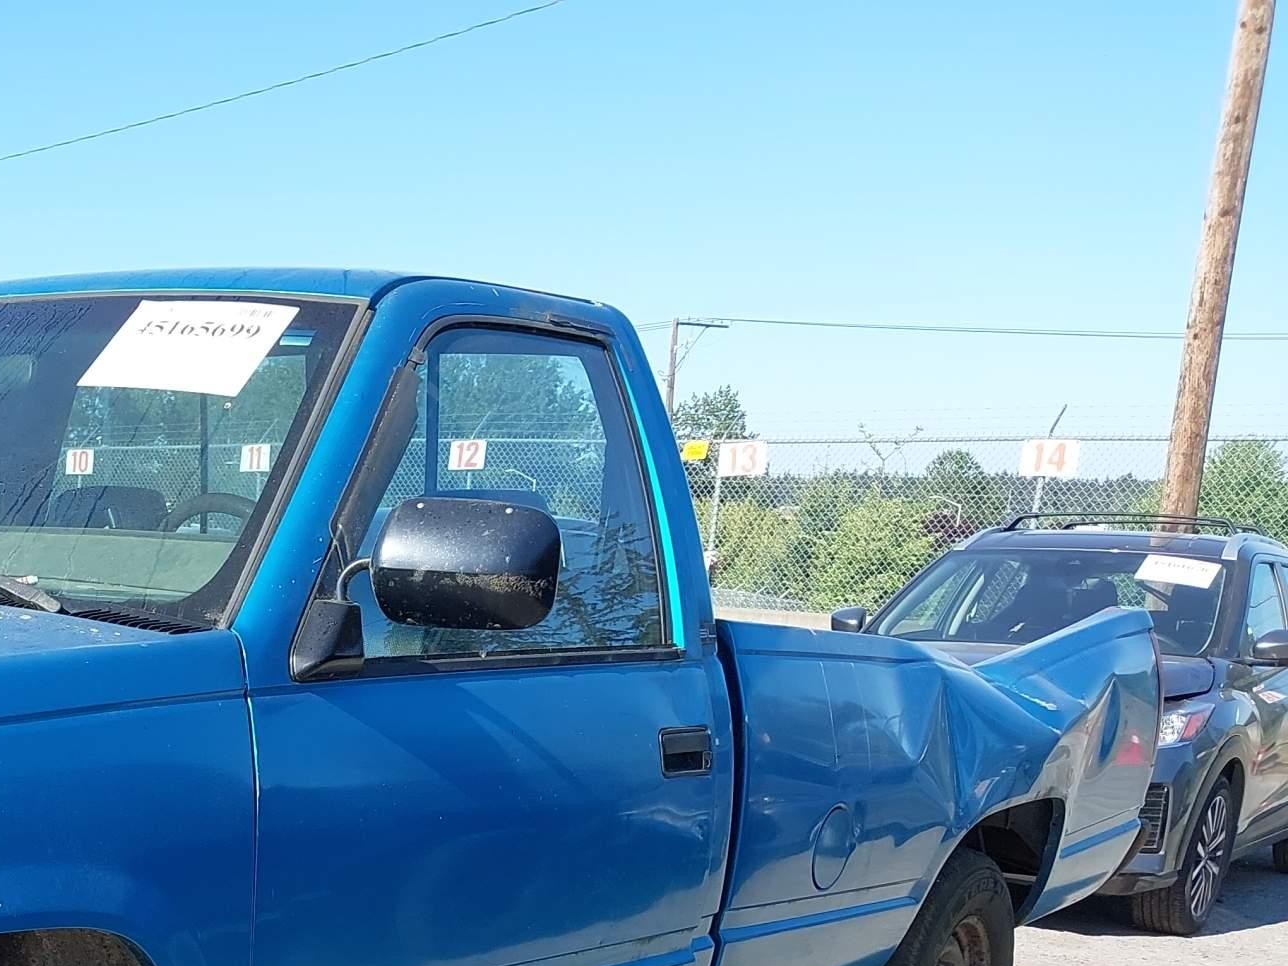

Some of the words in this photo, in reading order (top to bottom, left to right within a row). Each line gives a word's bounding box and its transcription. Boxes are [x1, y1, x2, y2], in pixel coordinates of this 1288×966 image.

[71, 451, 89, 473] 10
[247, 445, 262, 470] 11
[455, 441, 480, 467] 12
[727, 443, 759, 472] 13
[1034, 442, 1066, 472] 14
